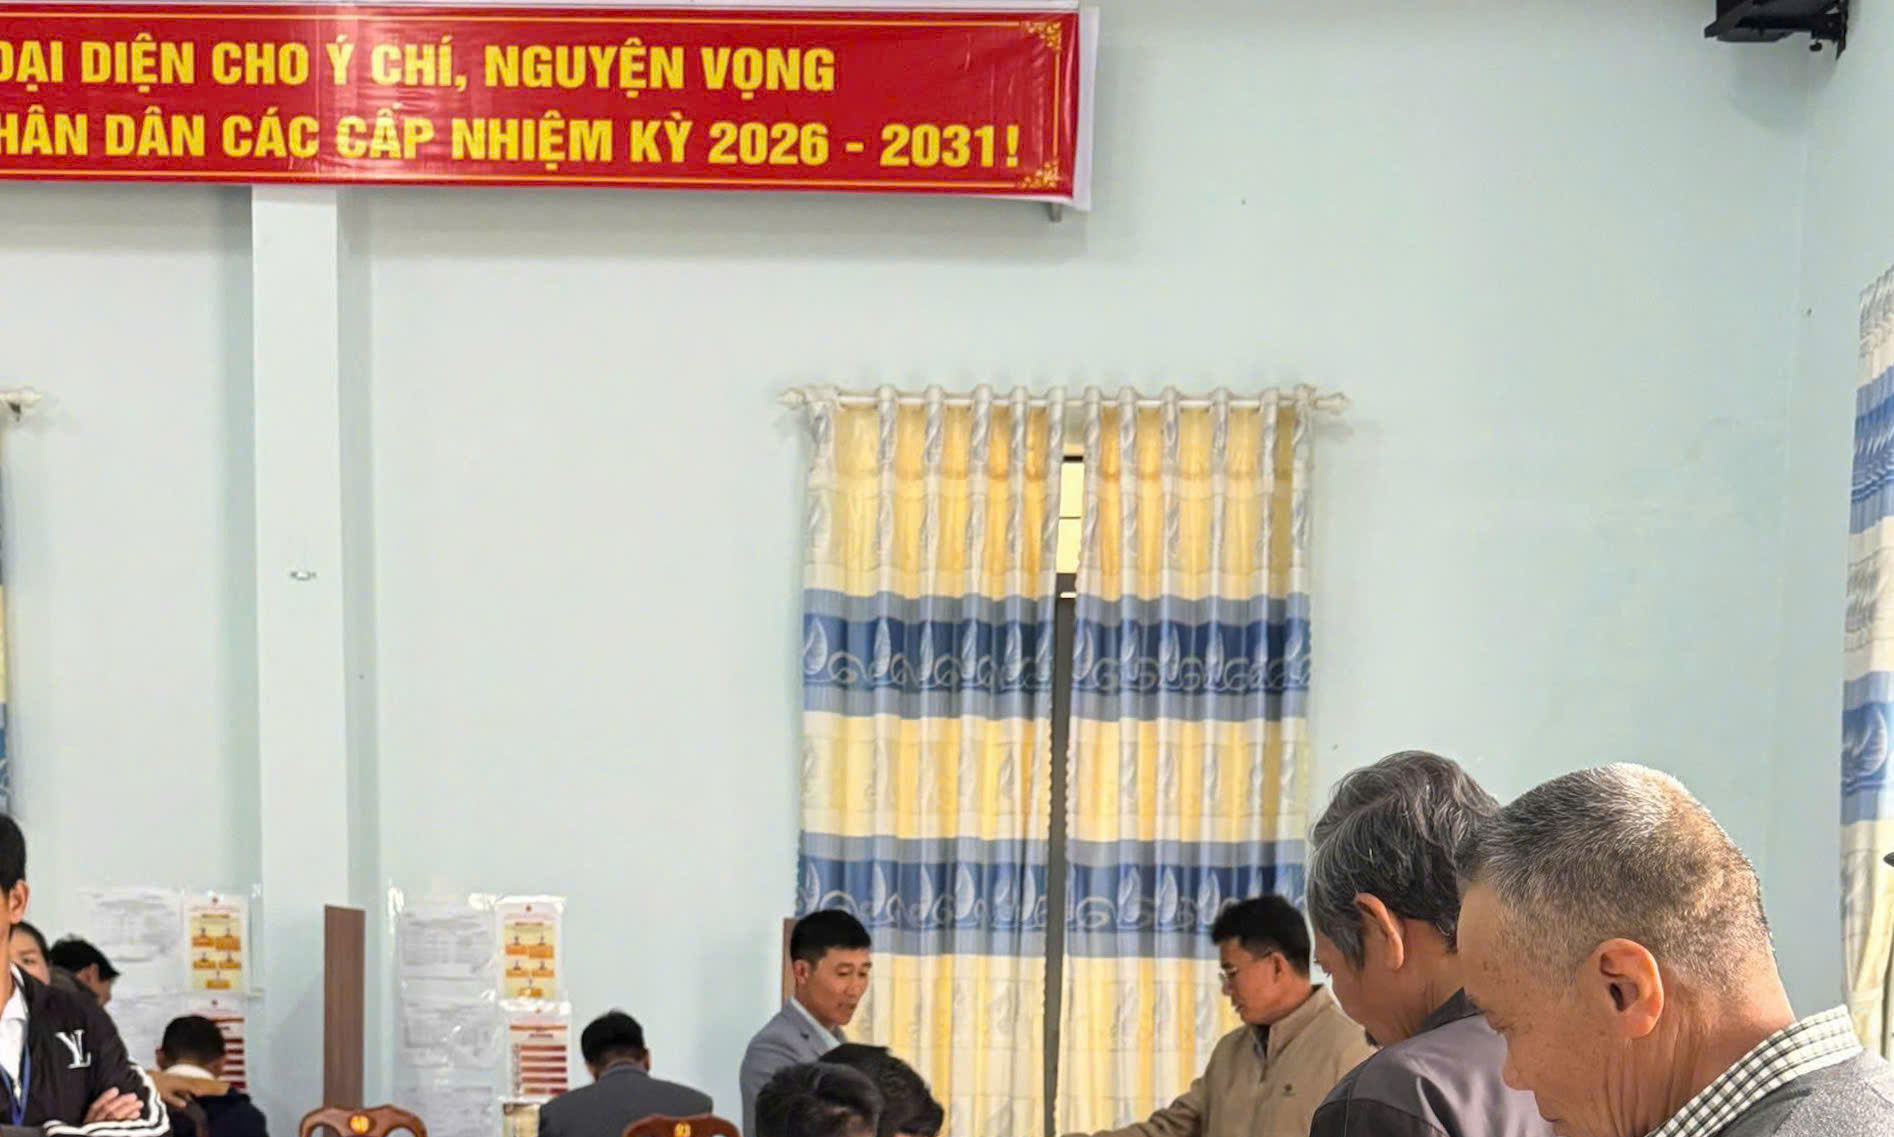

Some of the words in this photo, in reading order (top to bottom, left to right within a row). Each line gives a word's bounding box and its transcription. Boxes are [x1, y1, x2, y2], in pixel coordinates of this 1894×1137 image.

[81, 32, 195, 93] DIỆN
[212, 42, 309, 86] CHO
[326, 34, 355, 85] Ý
[370, 35, 467, 92] CHÍ,
[484, 37, 684, 99] NGUYỆN
[701, 47, 834, 100] VỌNG
[105, 105, 205, 157] DÂN
[222, 107, 320, 158] CÁC
[335, 102, 435, 160] CẤP
[450, 110, 613, 171] NHIỆM
[630, 112, 693, 164] KỲ
[708, 122, 829, 166] 2026
[846, 142, 864, 152] -
